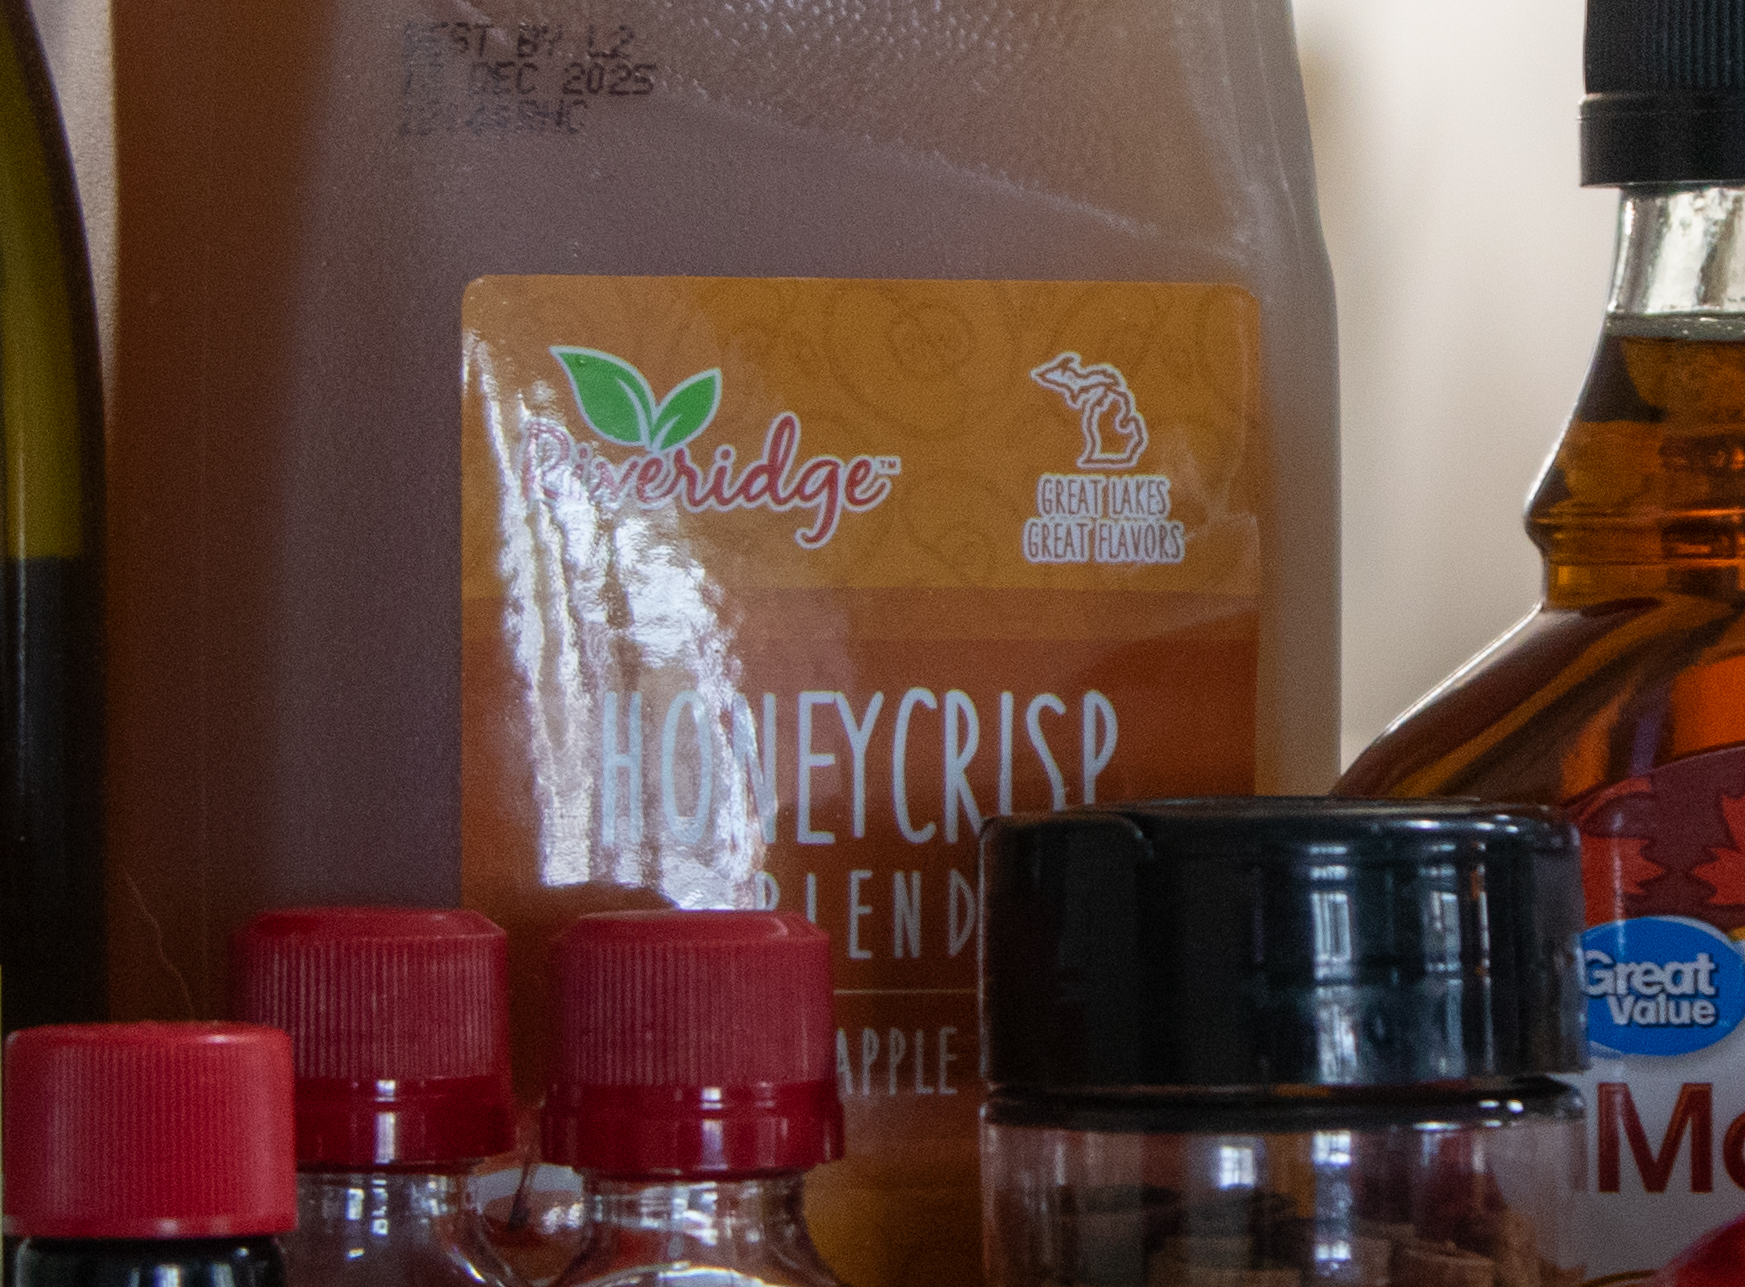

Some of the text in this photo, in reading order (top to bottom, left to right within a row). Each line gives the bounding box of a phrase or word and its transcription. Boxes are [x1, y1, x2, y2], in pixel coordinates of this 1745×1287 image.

[559, 62, 655, 95] 2025
[1041, 476, 1169, 516] GREAT LAKES
[1028, 521, 1183, 561] GREAT FLAVORS
[601, 689, 1119, 847] HONEYCRISP
[1581, 949, 1716, 998] Great
[1608, 995, 1717, 1026] Value
[835, 1026, 958, 1096] APPLE
